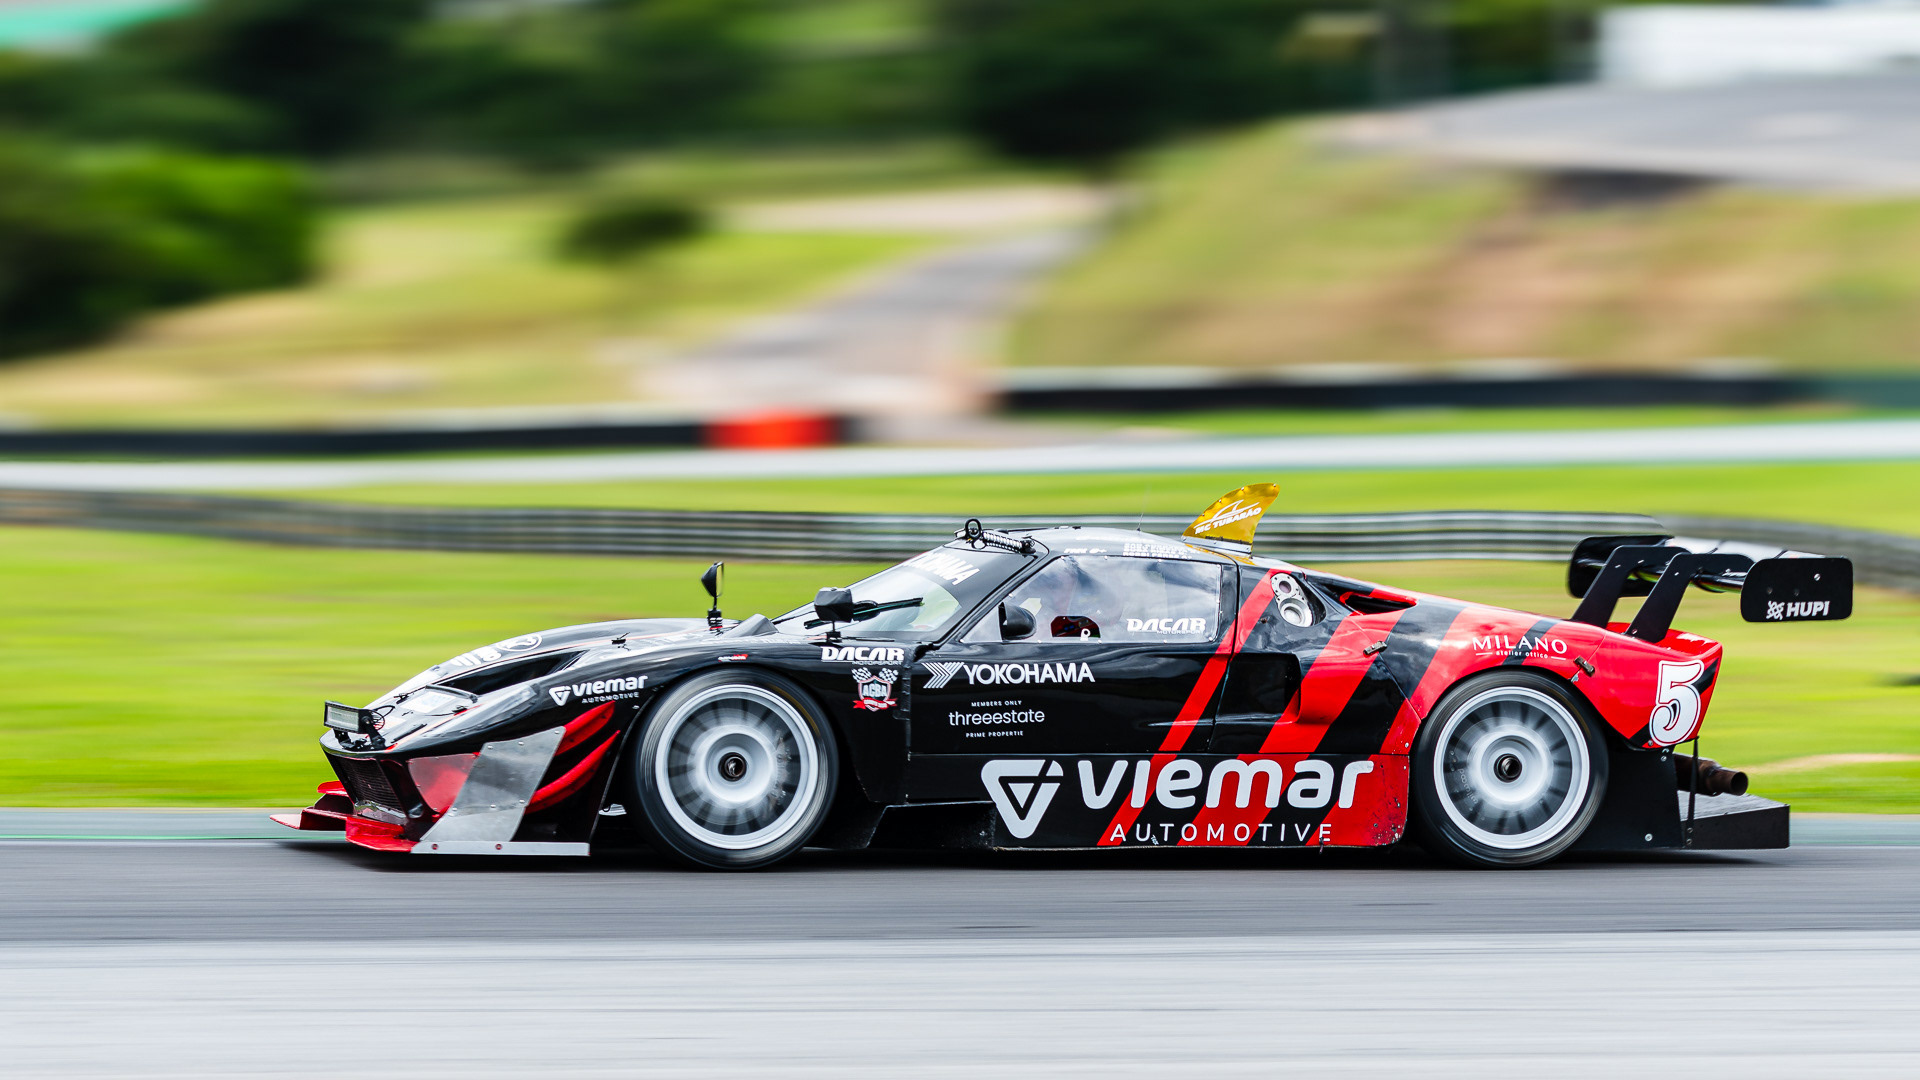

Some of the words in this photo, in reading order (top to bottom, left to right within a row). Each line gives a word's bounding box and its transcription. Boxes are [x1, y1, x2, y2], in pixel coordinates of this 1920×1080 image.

[1194, 523, 1211, 535] MC
[1786, 600, 1830, 617] HUPI
[1126, 617, 1207, 632] DACAR
[1472, 635, 1568, 654] MILANO
[820, 646, 905, 661] DACAR
[1525, 651, 1549, 659] ottico
[963, 662, 1096, 685] YOKOHAMA
[581, 692, 640, 704] AUTOMOTIVE
[1648, 659, 1706, 747] 5
[948, 708, 1046, 726] threeestate
[1109, 823, 1332, 842] AUTOMOTIVE
